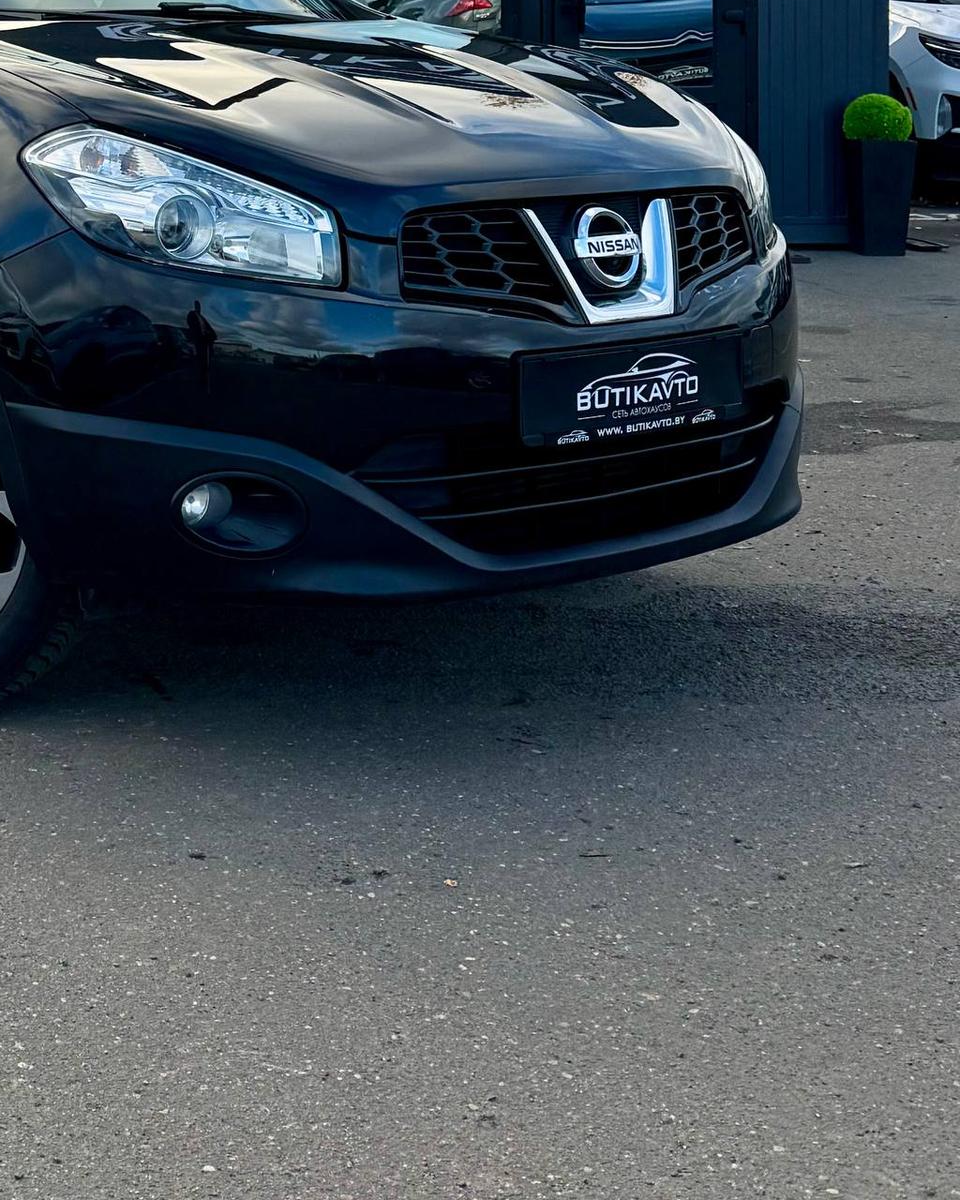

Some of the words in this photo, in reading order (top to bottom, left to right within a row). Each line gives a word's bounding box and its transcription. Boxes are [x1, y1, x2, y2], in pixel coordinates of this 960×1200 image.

[587, 237, 640, 254] NISSAN
[576, 375, 699, 412] BUTIKAVTO
[611, 409, 629, 419] СЕТЬ
[596, 425, 624, 437] WWW.
[626, 415, 686, 433] BUTIKAVTO.BY
